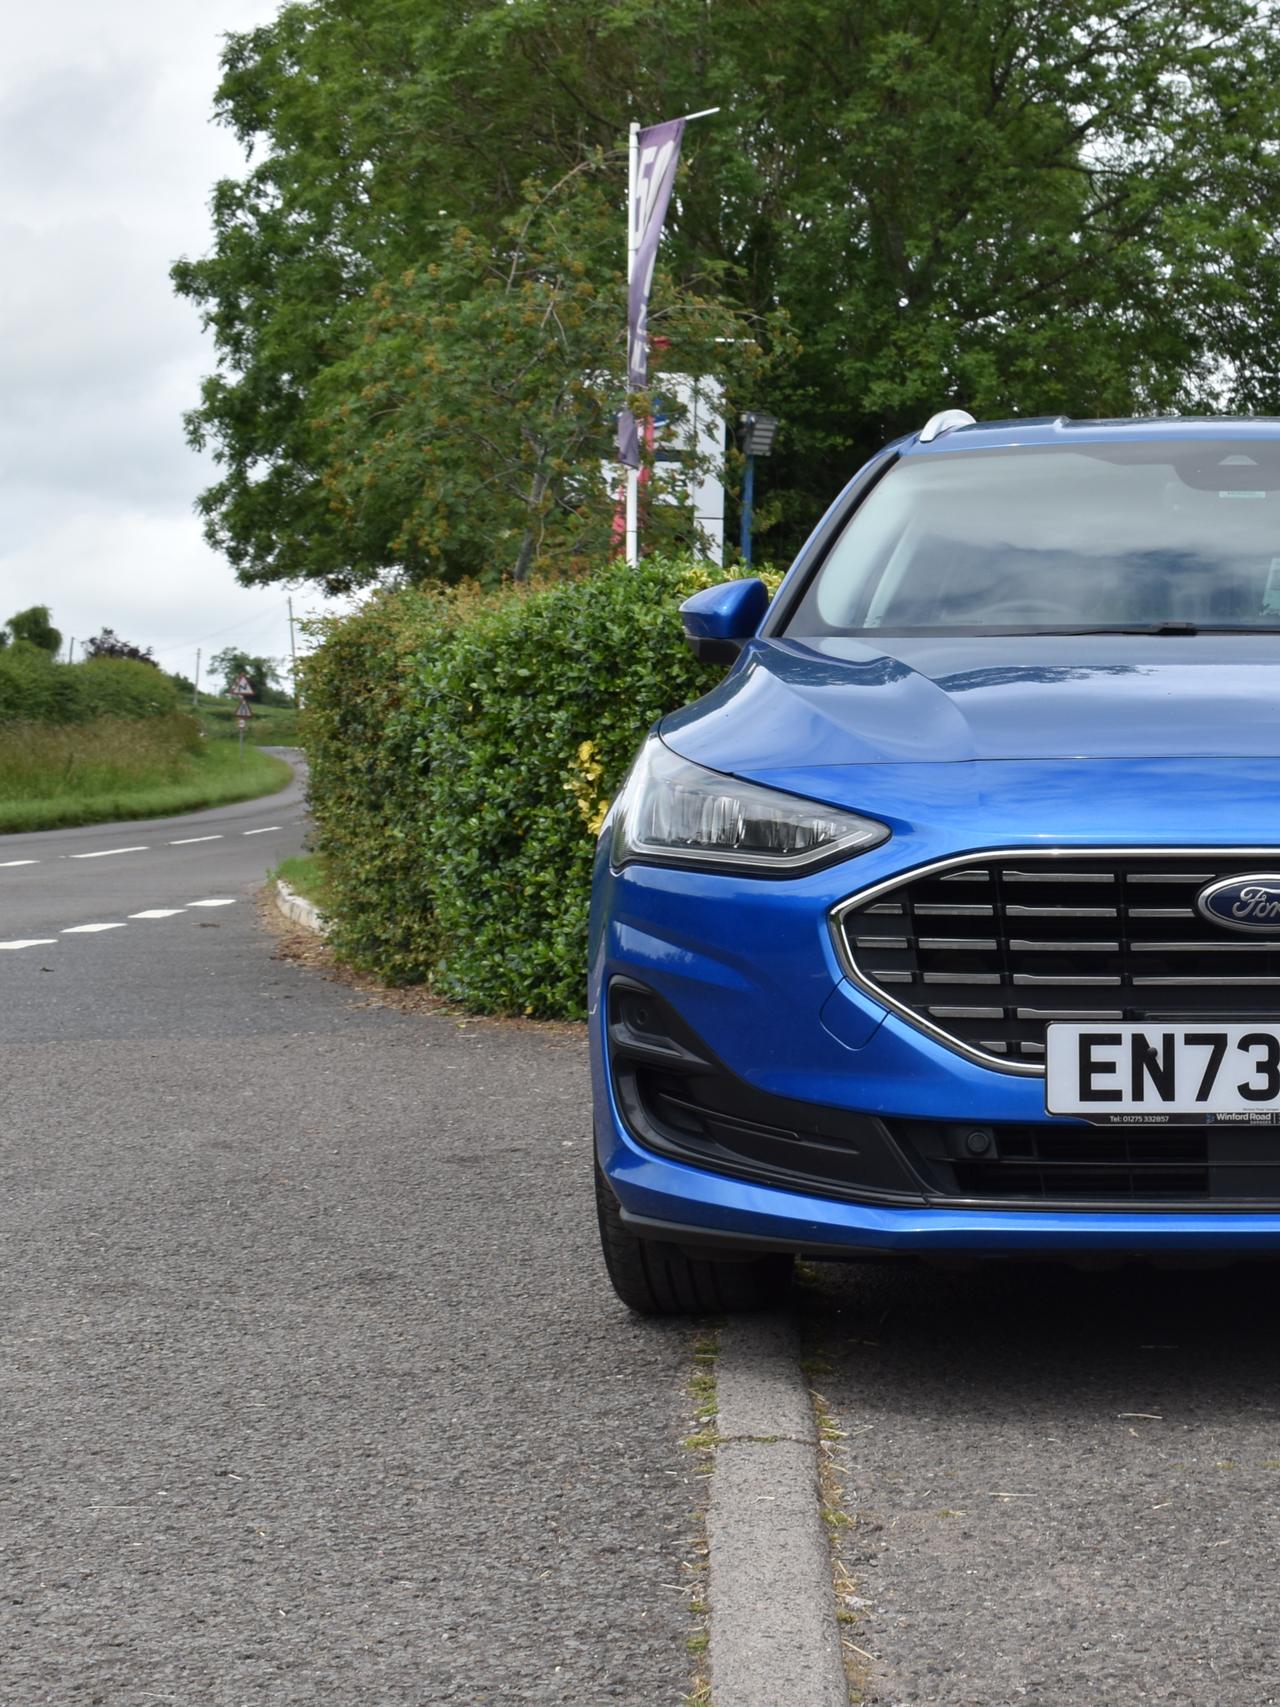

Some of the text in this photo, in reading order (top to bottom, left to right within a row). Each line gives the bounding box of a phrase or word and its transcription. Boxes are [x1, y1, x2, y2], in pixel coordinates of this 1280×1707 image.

[1078, 1032, 1280, 1103] EN73
[1109, 1115, 1122, 1123] Tel:
[1122, 1115, 1143, 1123] 01275
[1216, 1113, 1249, 1121] Winford
[1249, 1112, 1271, 1121] Road
